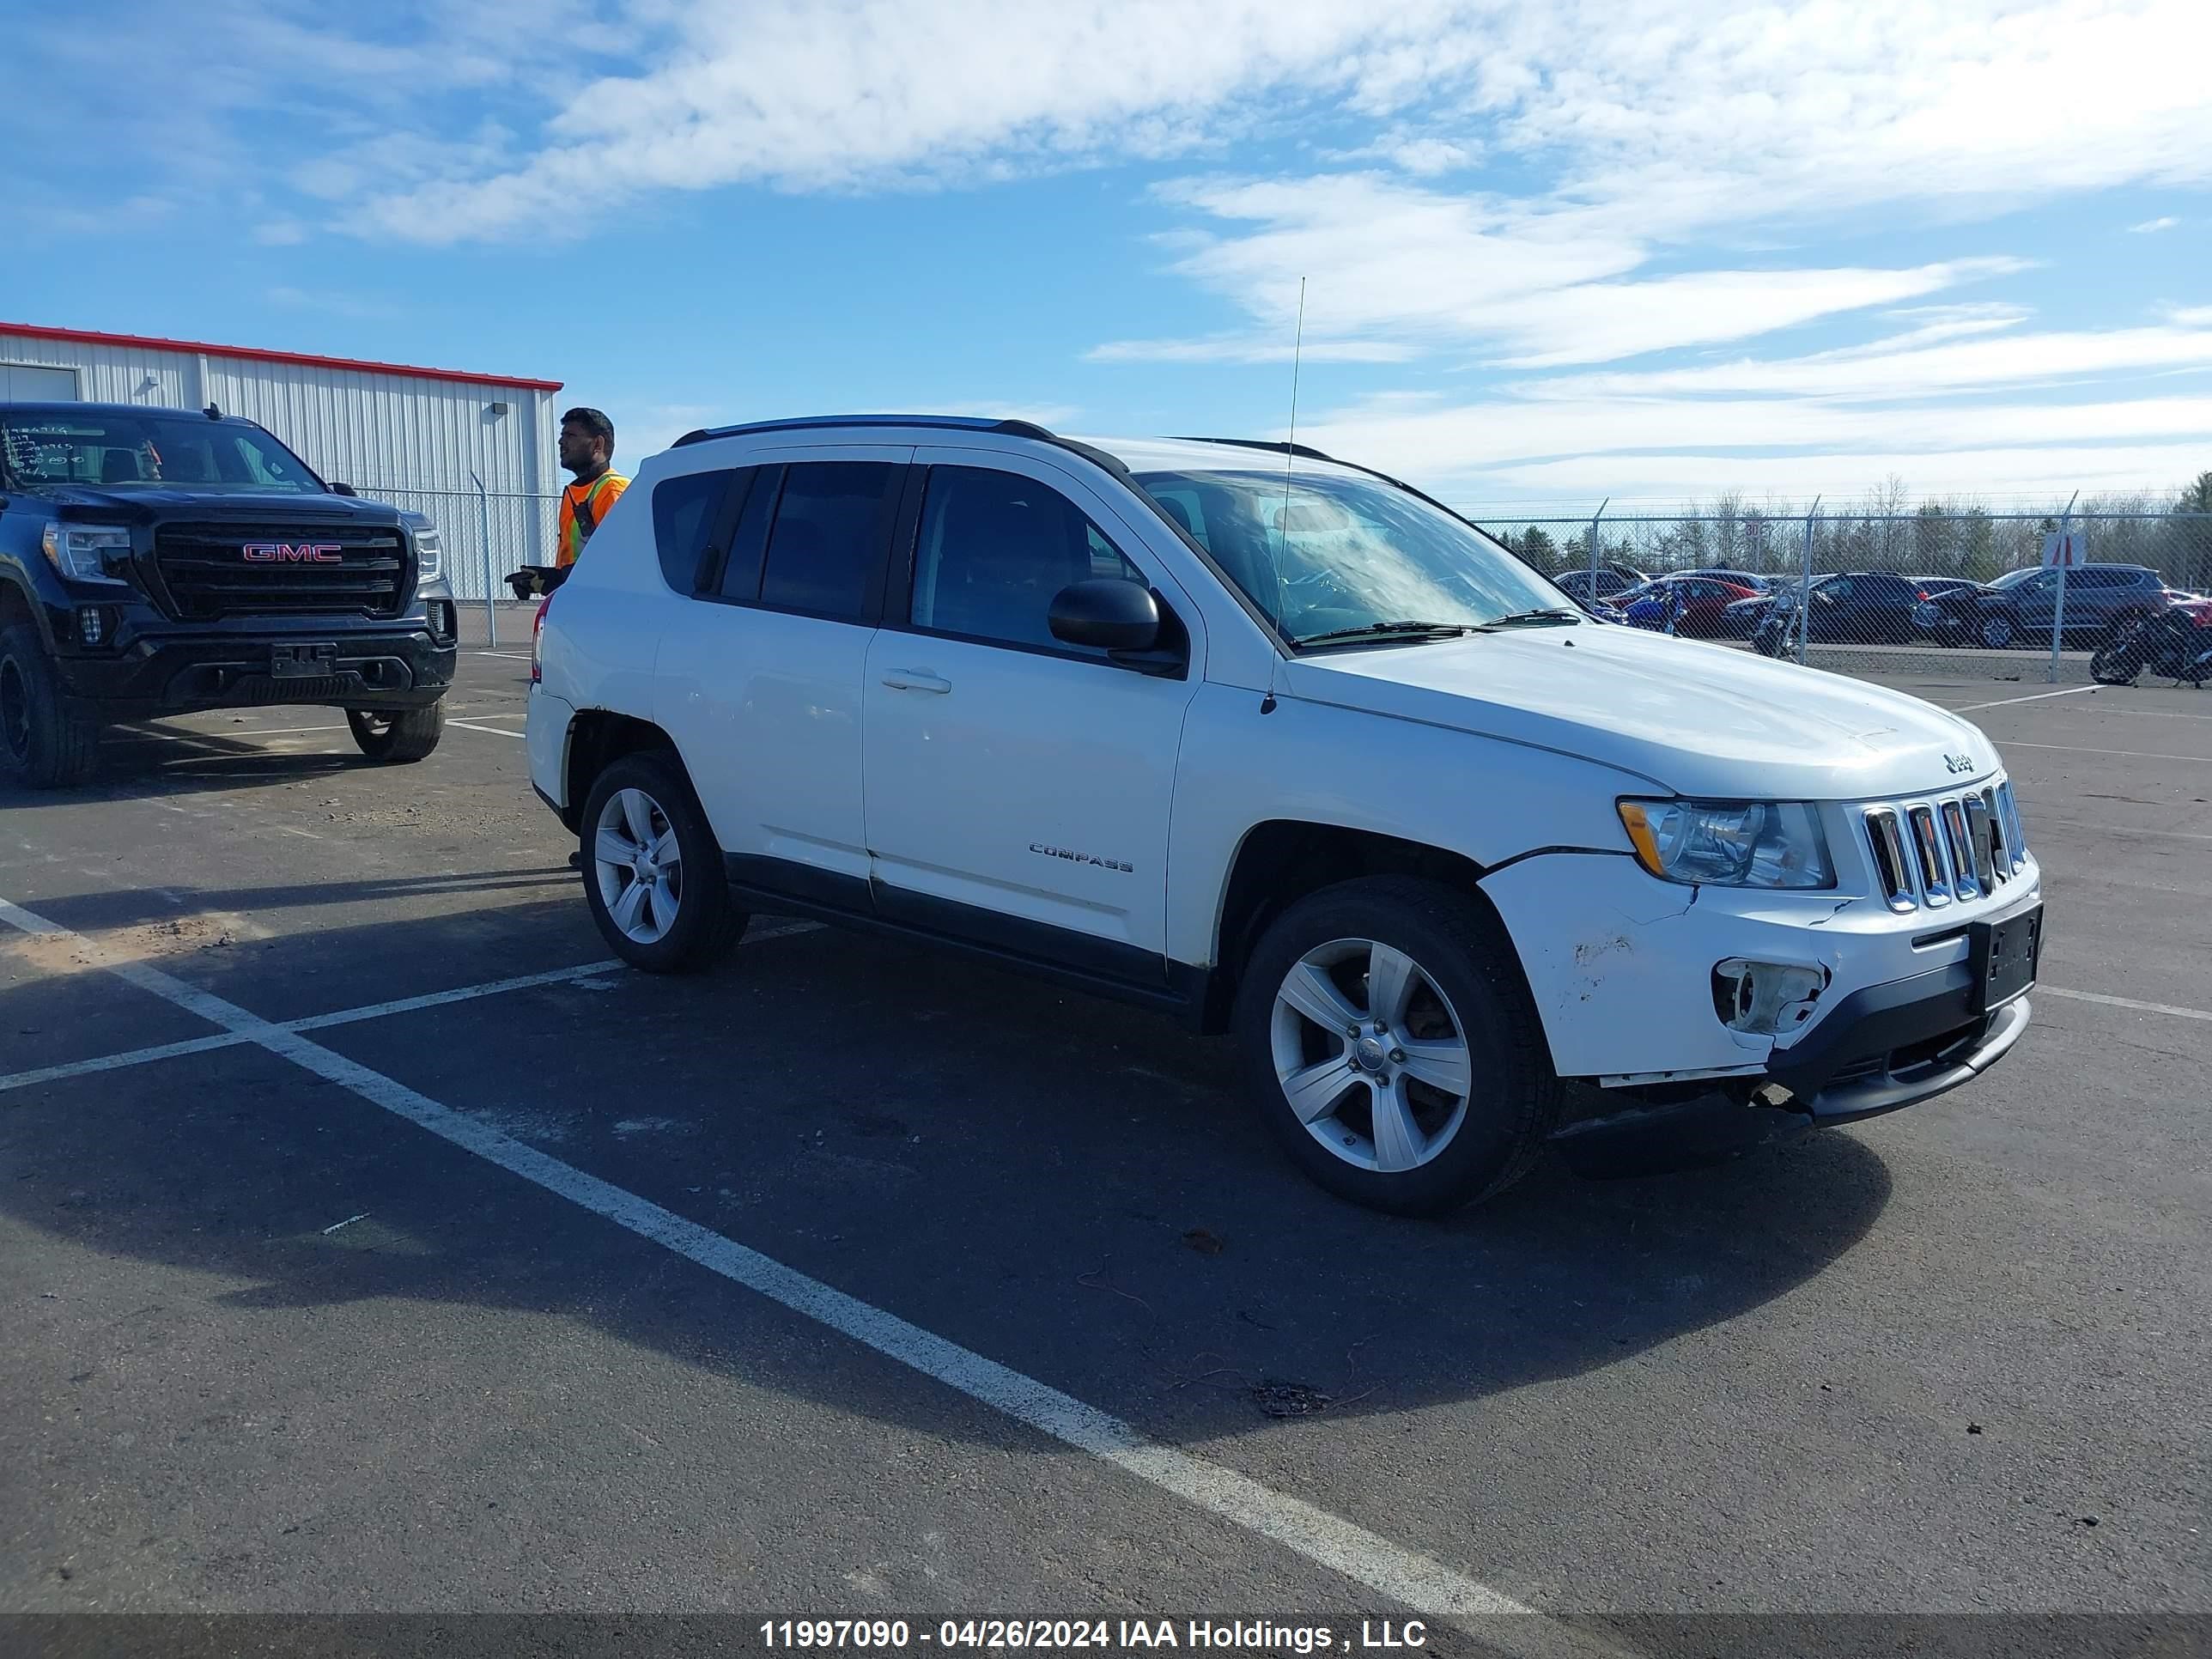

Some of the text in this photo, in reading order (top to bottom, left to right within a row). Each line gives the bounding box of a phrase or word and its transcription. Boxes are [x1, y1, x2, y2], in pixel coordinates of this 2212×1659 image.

[1746, 524, 1759, 536] 30
[243, 544, 343, 562] GMC
[1942, 753, 1975, 775] Jeep
[1029, 842, 1134, 873] COMPASS
